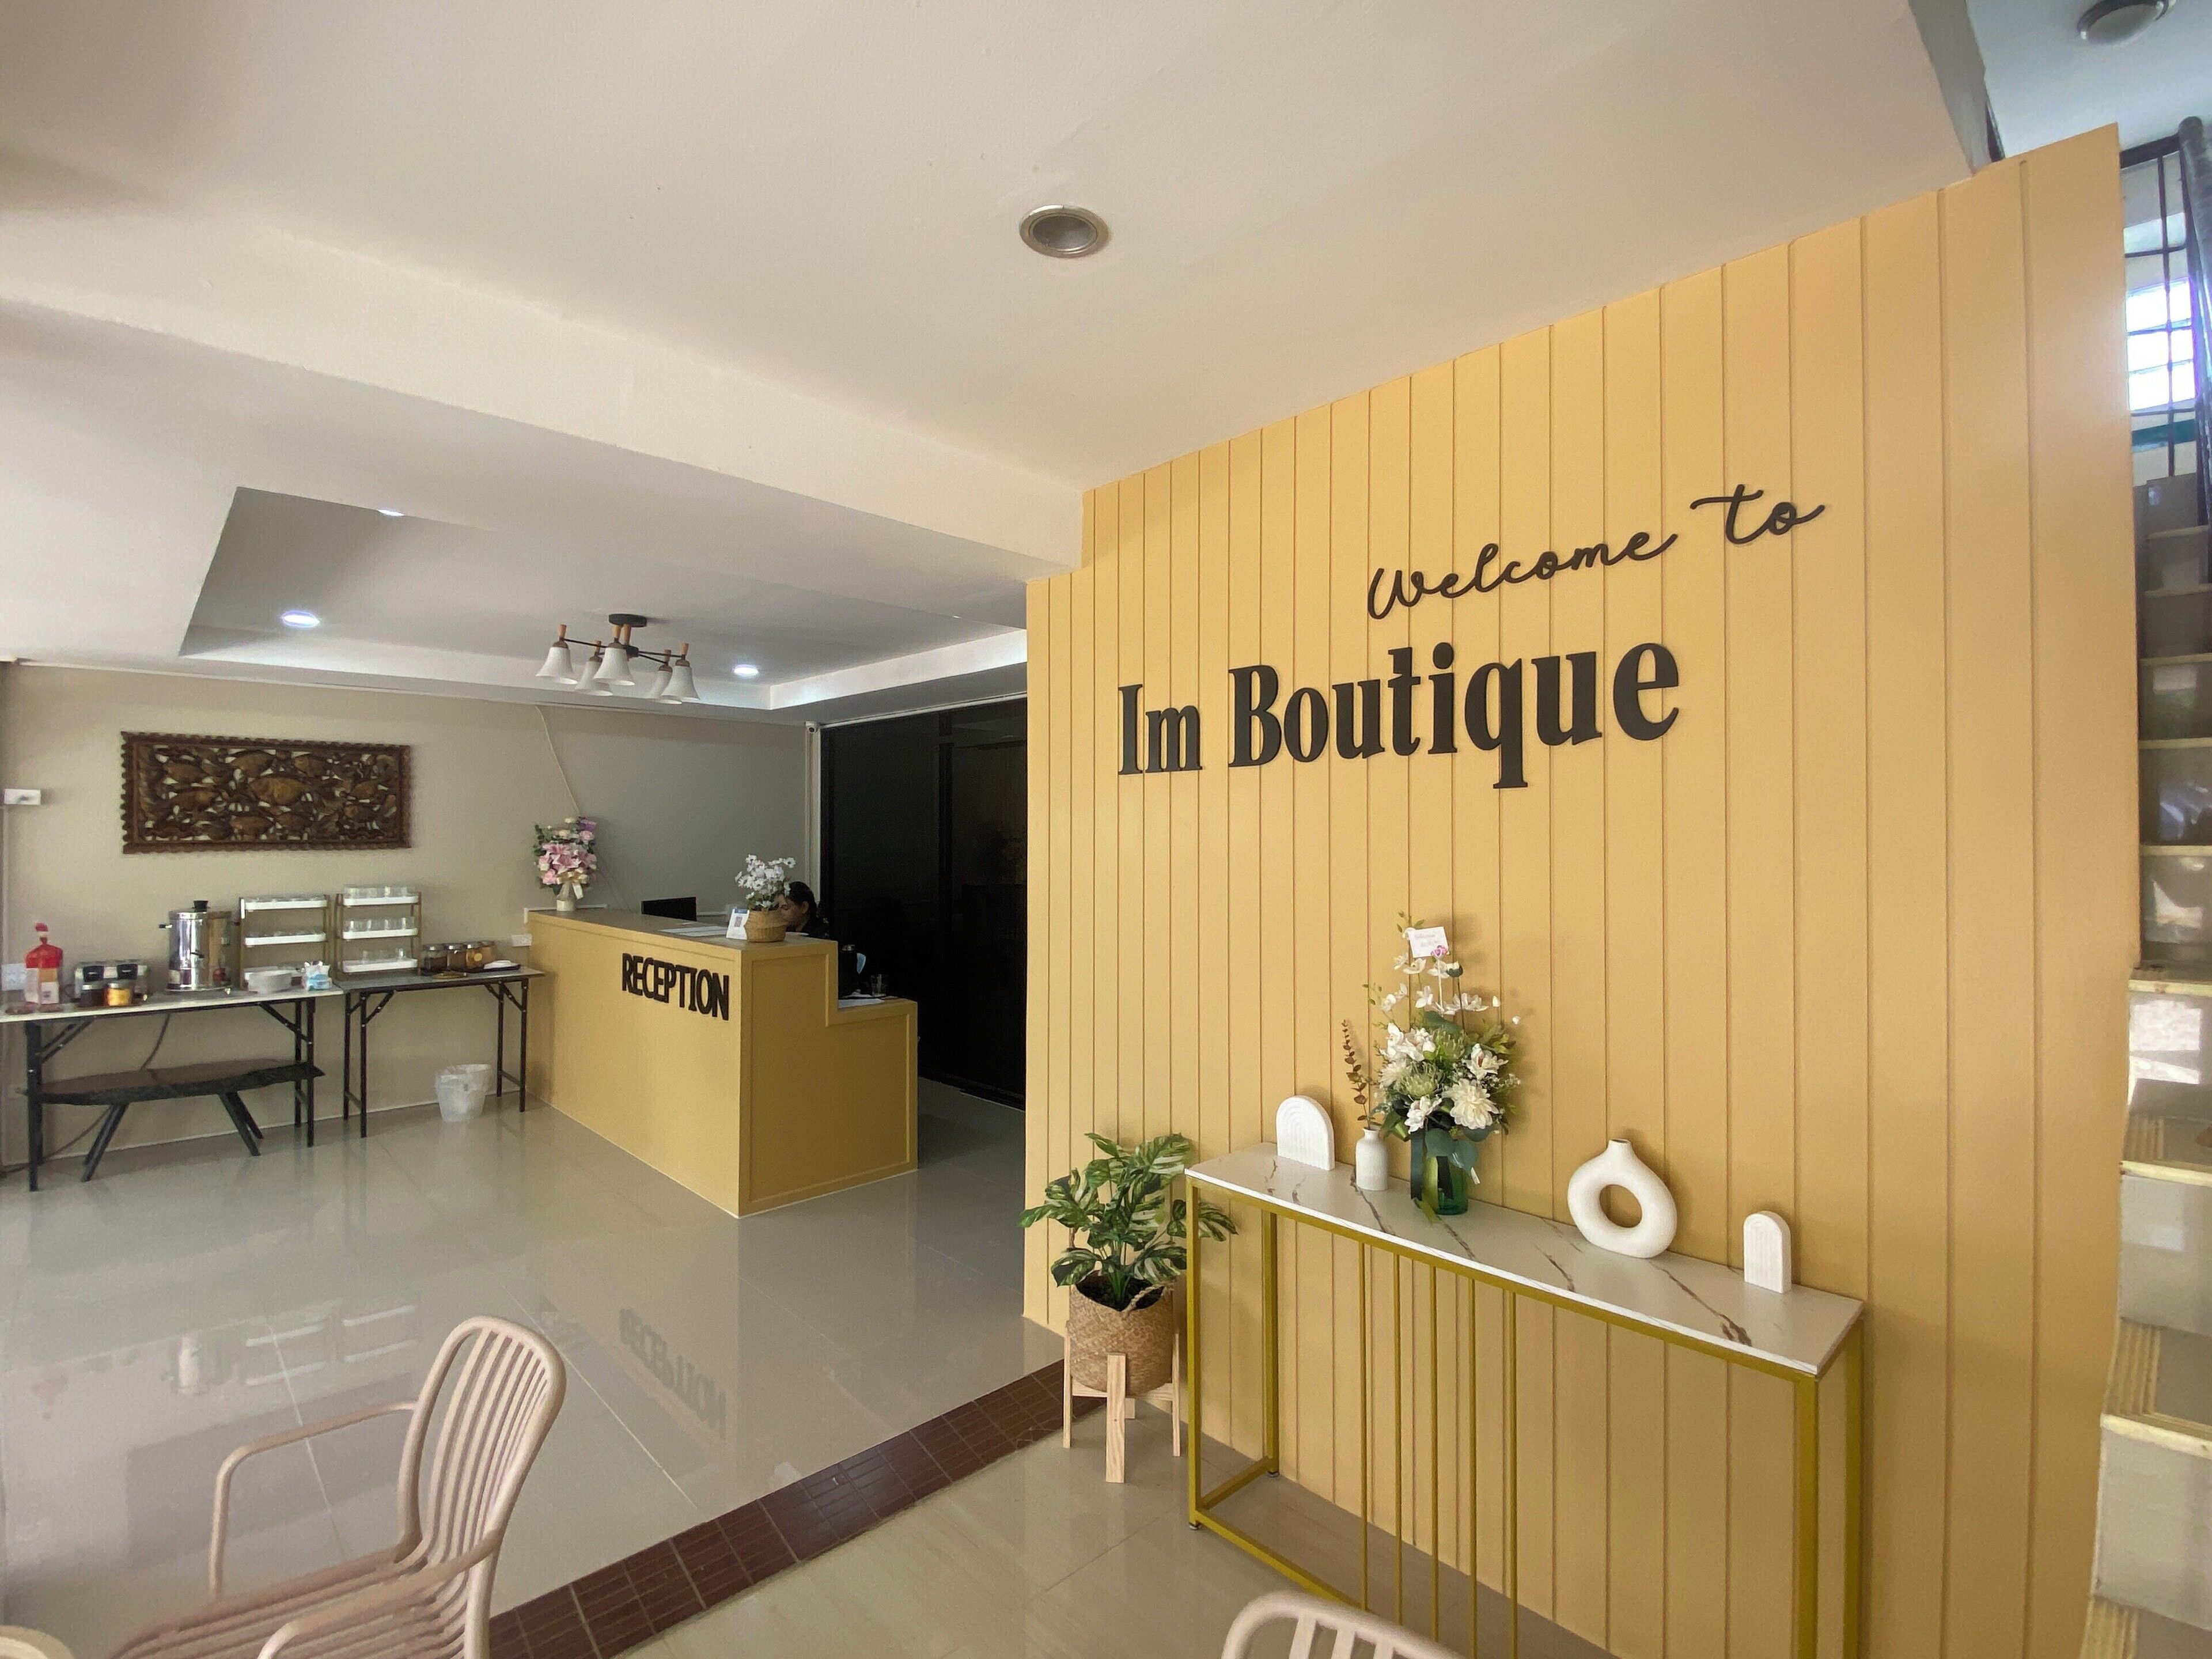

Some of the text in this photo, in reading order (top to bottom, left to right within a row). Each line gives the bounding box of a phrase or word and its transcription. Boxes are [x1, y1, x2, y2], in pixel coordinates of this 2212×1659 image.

[1367, 484, 1825, 620] Welcome to
[1118, 642, 1679, 789] Im Boutique
[622, 953, 729, 1021] RECEPTION
